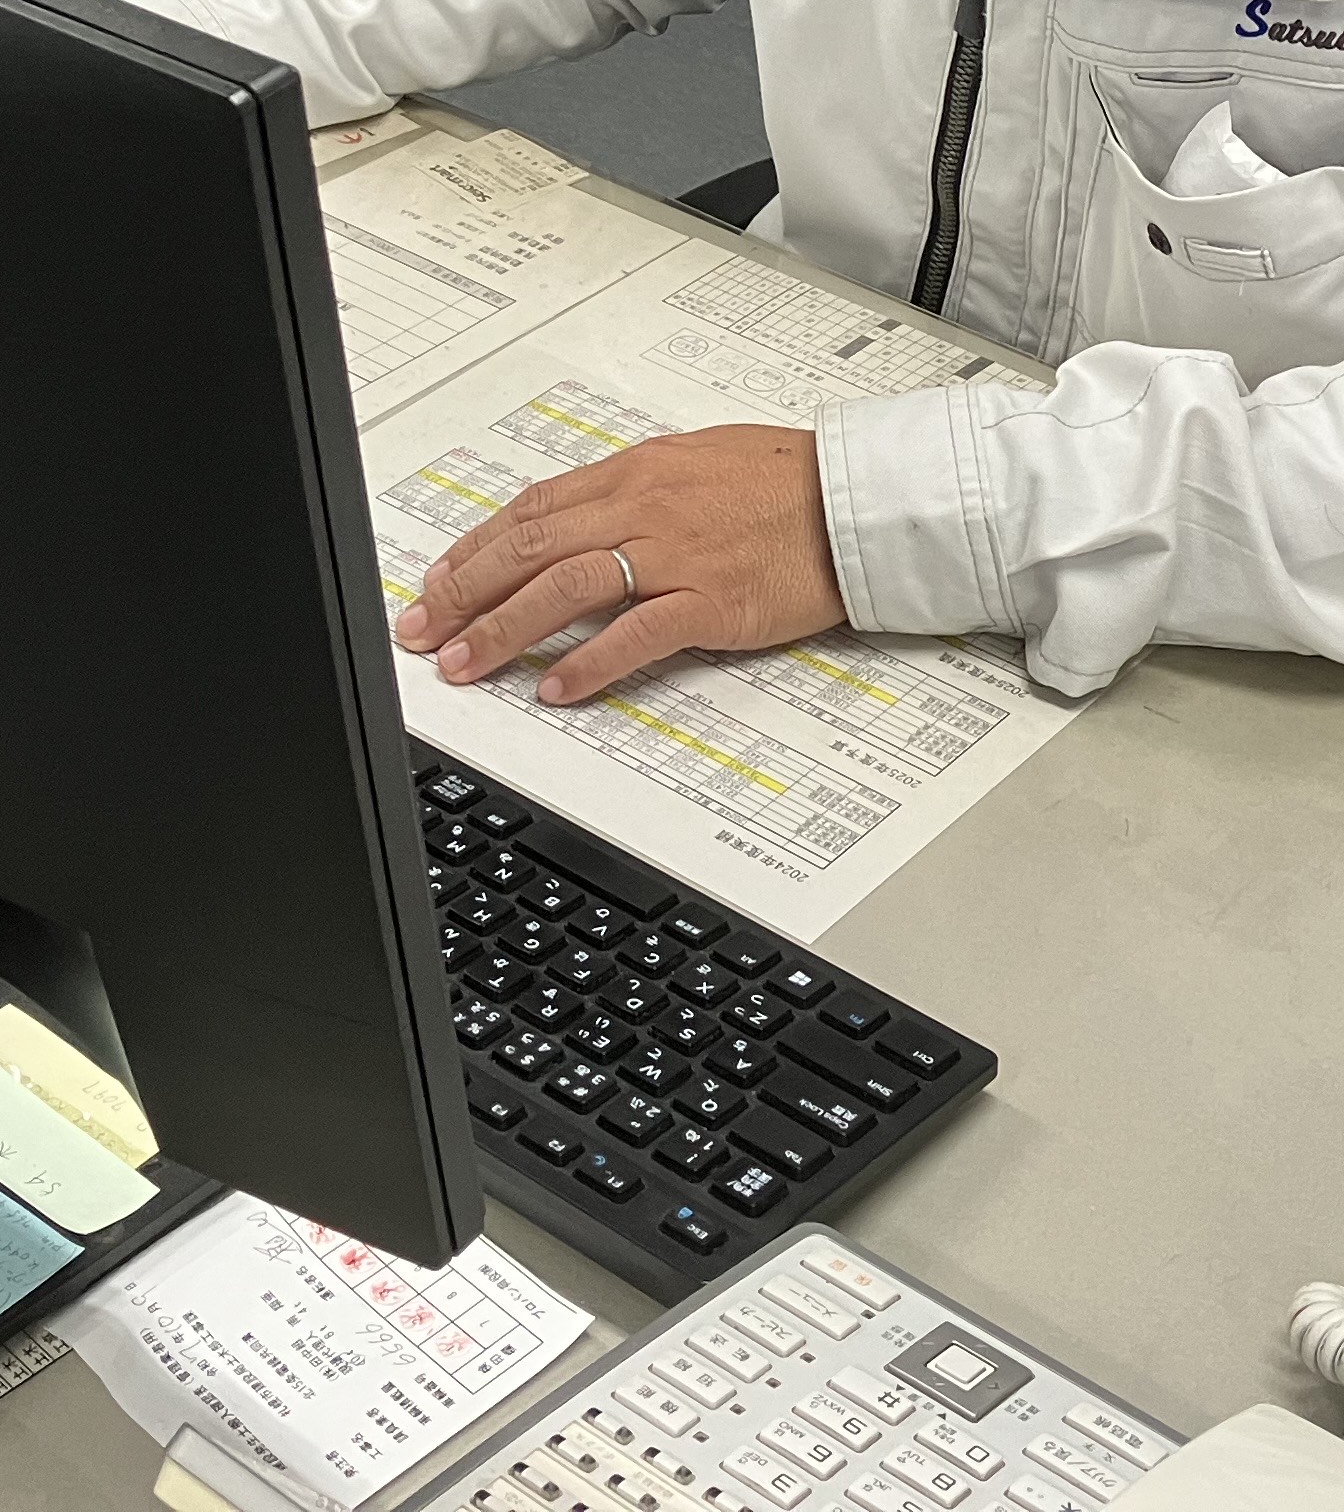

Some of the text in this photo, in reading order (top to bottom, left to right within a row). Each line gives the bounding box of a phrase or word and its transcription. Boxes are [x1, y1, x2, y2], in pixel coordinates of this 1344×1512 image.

[937, 648, 1028, 703] 2025年度実績
[829, 735, 921, 793] 2025年度予算
[446, 839, 465, 852] M
[714, 825, 808, 886] 2024年度実績
[493, 867, 512, 878] N
[544, 896, 560, 906] B
[472, 909, 491, 921] H
[591, 923, 607, 935] V
[523, 938, 539, 948] G
[643, 951, 659, 963] C
[573, 967, 590, 979] F
[488, 974, 504, 986] T
[695, 980, 713, 993] X
[626, 997, 643, 1009] D
[484, 1011, 500, 1022] 5
[540, 1004, 557, 1016] R
[748, 1011, 767, 1024] Z
[678, 1026, 695, 1039] S
[593, 1035, 610, 1048] E
[735, 1057, 751, 1069] A
[912, 1049, 933, 1064] Ctrl
[638, 1063, 662, 1080] W
[590, 1074, 605, 1084] 3
[866, 1078, 891, 1096] Shift
[645, 1105, 660, 1117] 2
[701, 1098, 717, 1111] Q
[738, 1304, 792, 1340] スピーカ
[19, 1341, 47, 1370] 土木
[0, 1354, 27, 1383] 土木
[811, 1392, 846, 1416] WXYZ
[777, 1419, 806, 1438] MNO
[841, 1416, 868, 1435] 9
[349, 1429, 383, 1463] 工事名
[806, 1443, 832, 1462] 6
[744, 1450, 768, 1466] DEF
[900, 1448, 926, 1466] TUV
[965, 1443, 990, 1463] 0
[770, 1472, 797, 1493] 3
[931, 1471, 956, 1491] 8
